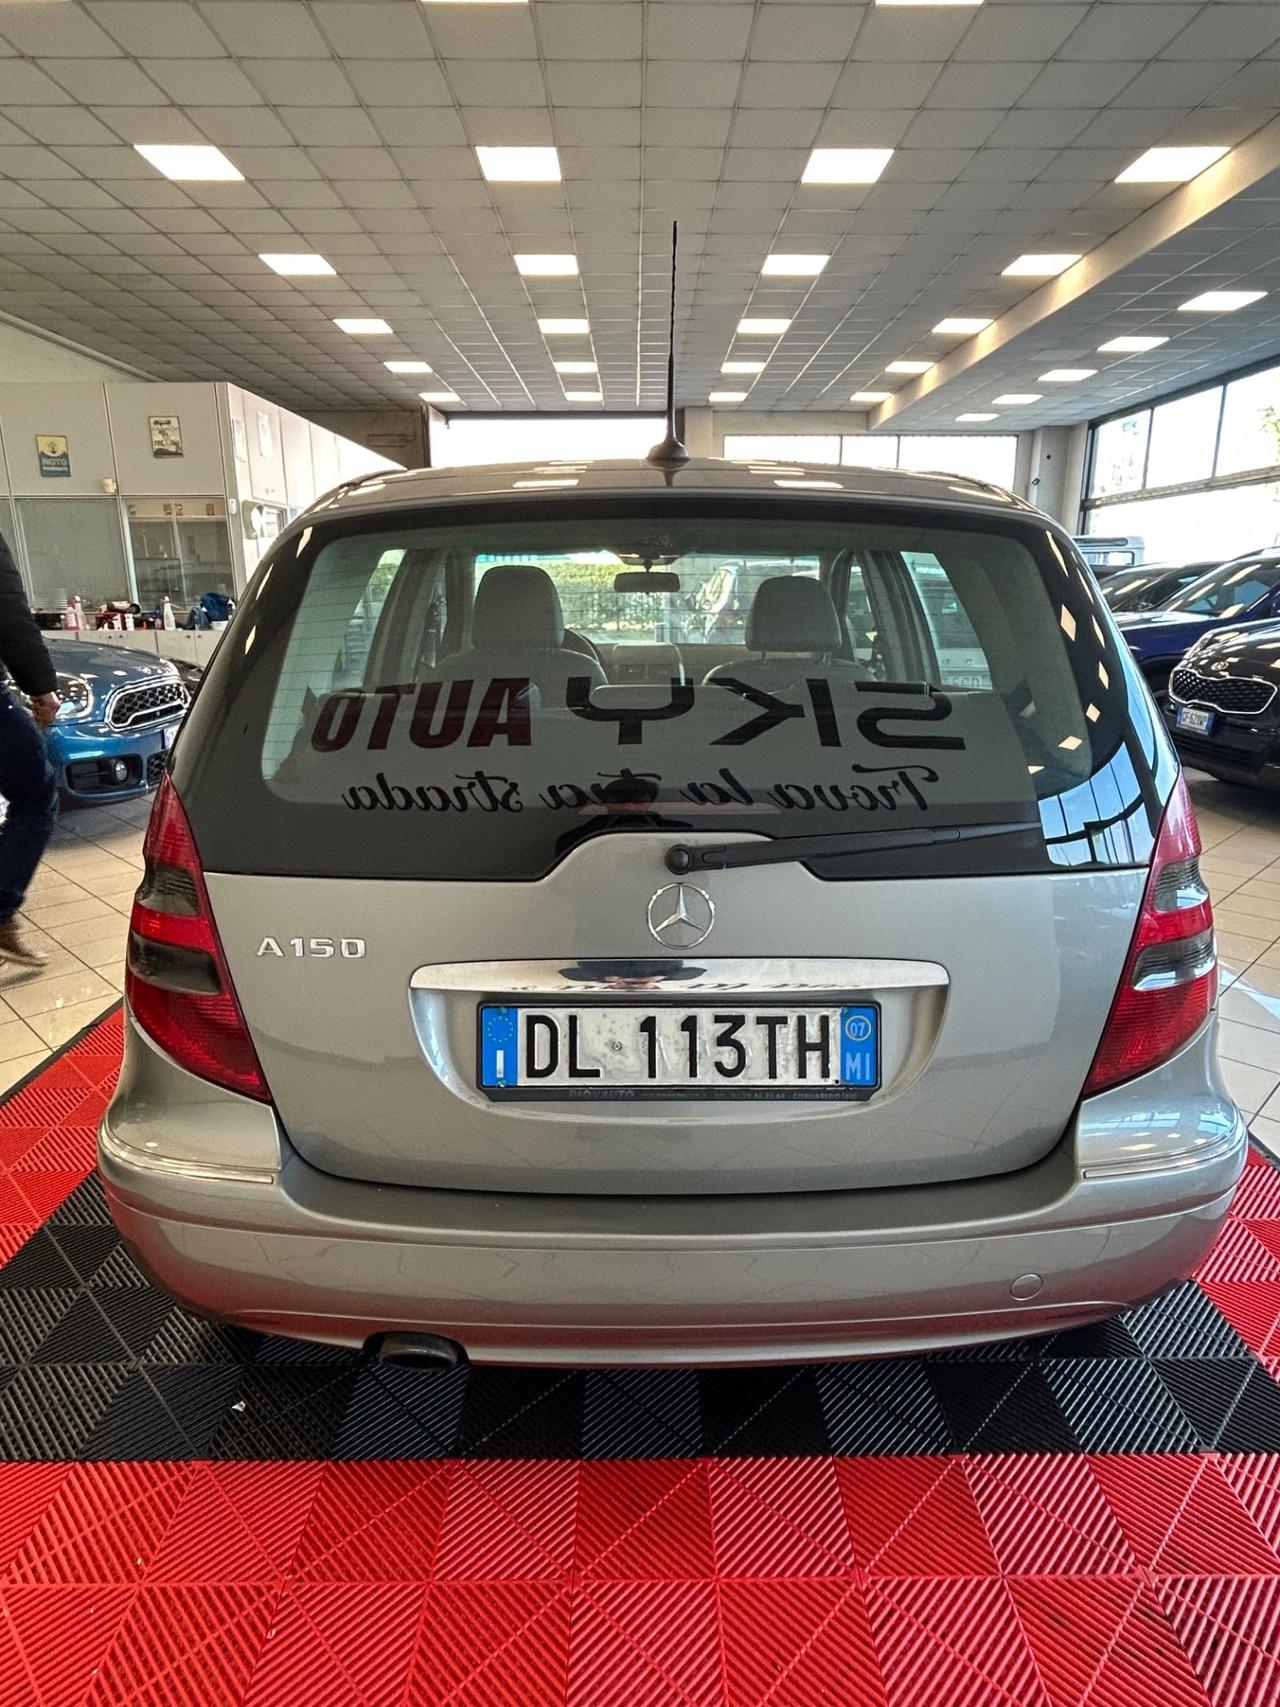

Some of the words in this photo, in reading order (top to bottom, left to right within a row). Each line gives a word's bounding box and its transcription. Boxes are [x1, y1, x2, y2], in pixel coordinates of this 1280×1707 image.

[256, 936, 366, 958] A150
[850, 1022, 865, 1037] 07
[525, 1014, 601, 1079] DL
[639, 1014, 831, 1079] 113TH
[845, 1052, 871, 1081] MI
